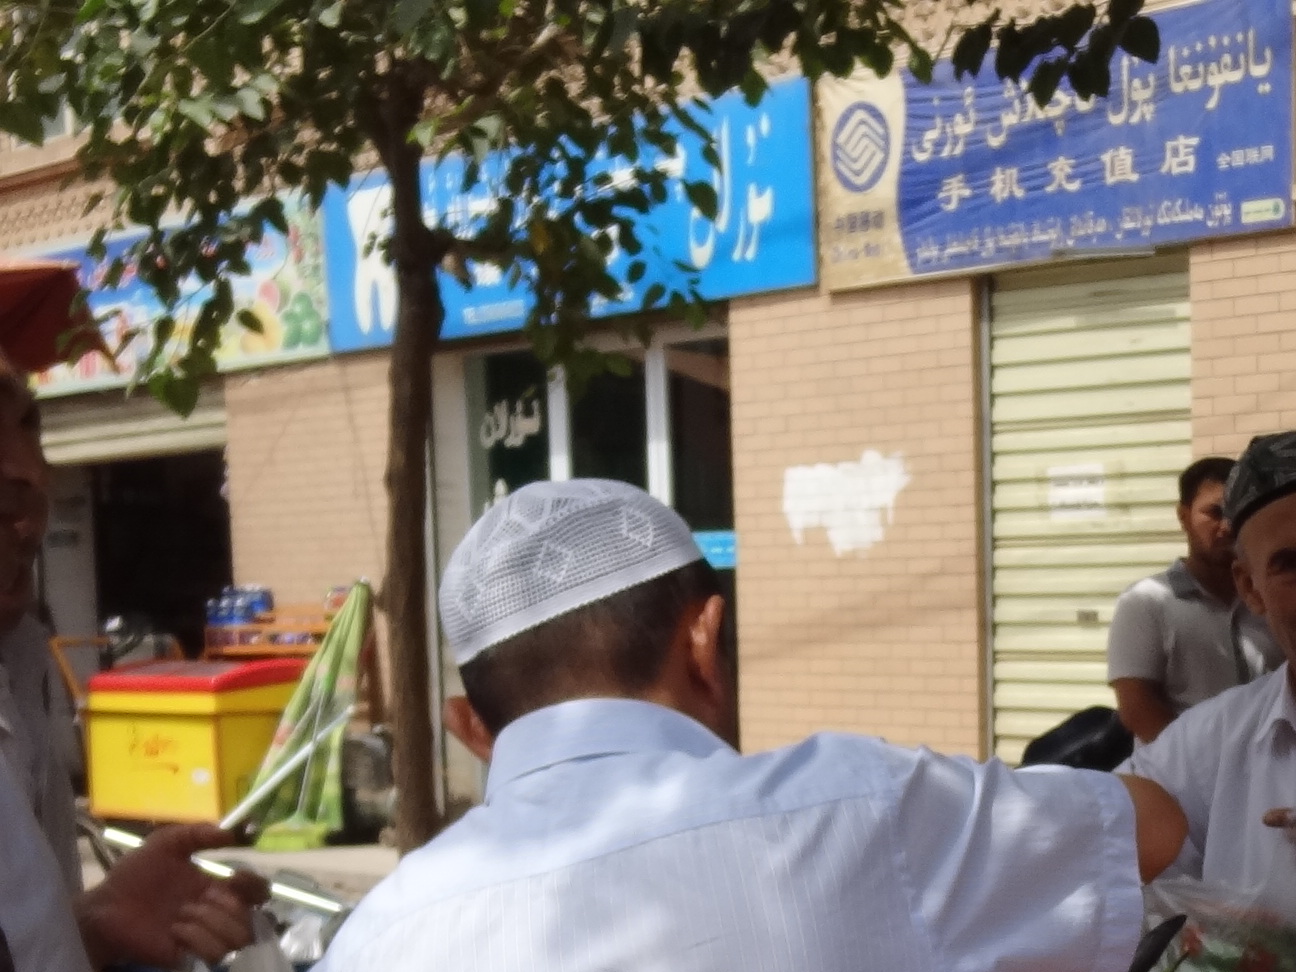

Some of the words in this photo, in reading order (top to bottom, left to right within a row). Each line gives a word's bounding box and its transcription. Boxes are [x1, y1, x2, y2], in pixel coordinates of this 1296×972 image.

[937, 134, 1200, 212] 手机充值店
